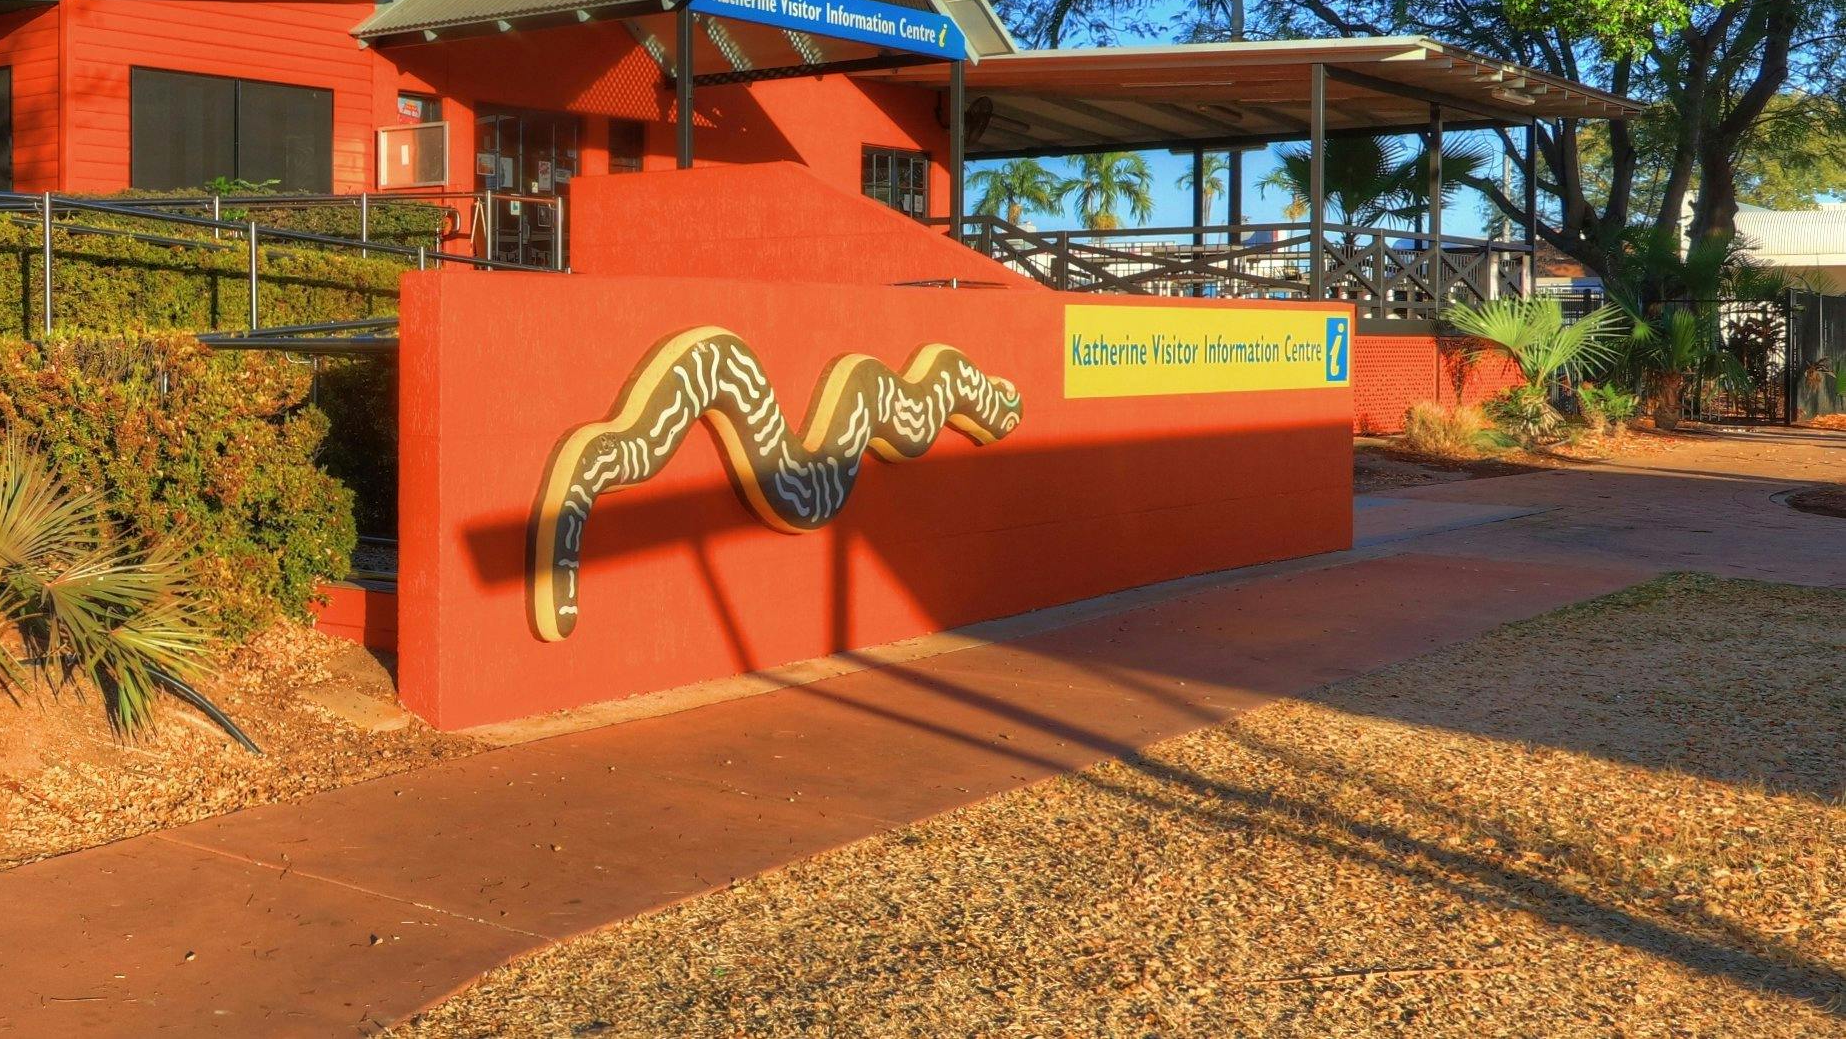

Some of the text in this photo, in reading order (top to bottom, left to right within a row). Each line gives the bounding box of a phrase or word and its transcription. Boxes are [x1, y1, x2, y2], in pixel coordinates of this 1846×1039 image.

[826, 2, 896, 36] Information
[899, 17, 936, 44] Centre
[1072, 333, 1147, 366] Katherine
[1152, 334, 1199, 365] Visitor
[1204, 334, 1280, 364] Information
[1284, 334, 1322, 363] Centre
